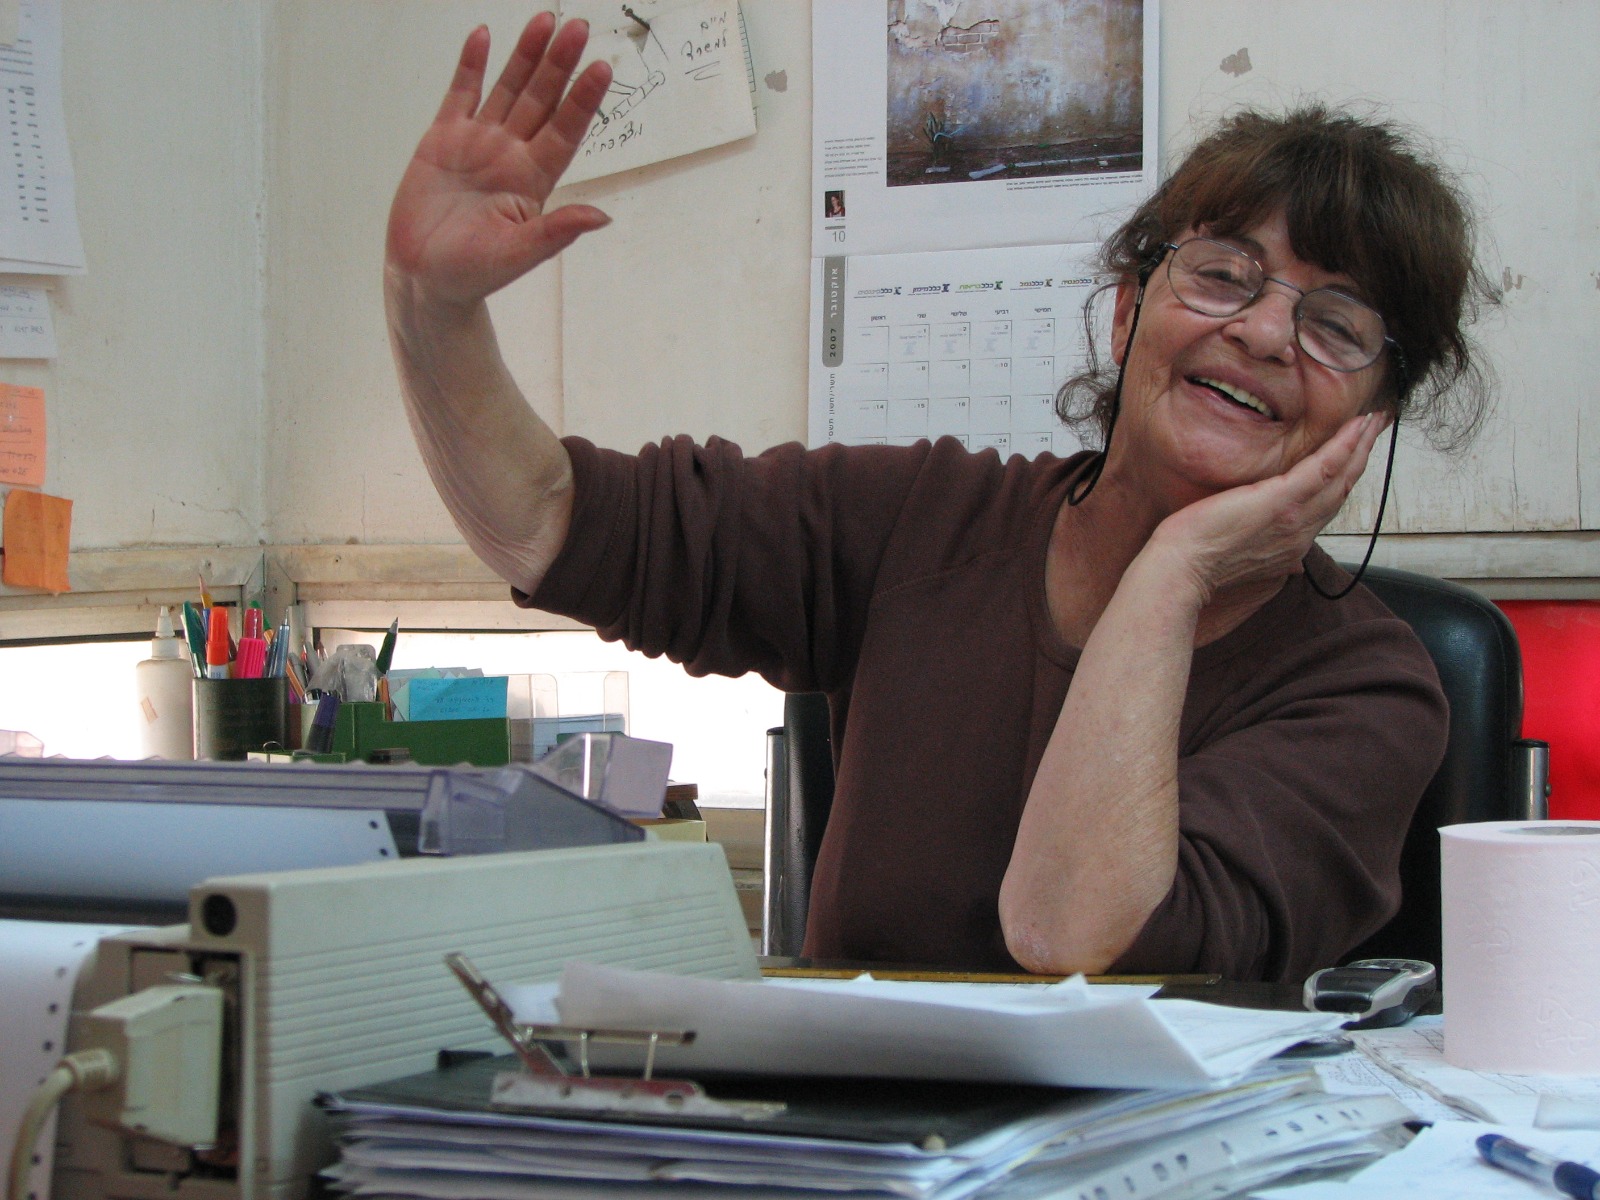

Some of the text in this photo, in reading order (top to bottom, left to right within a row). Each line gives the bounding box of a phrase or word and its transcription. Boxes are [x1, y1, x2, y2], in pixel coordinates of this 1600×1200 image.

[832, 230, 846, 243] 10
[829, 268, 839, 358] אוקטובר 2007
